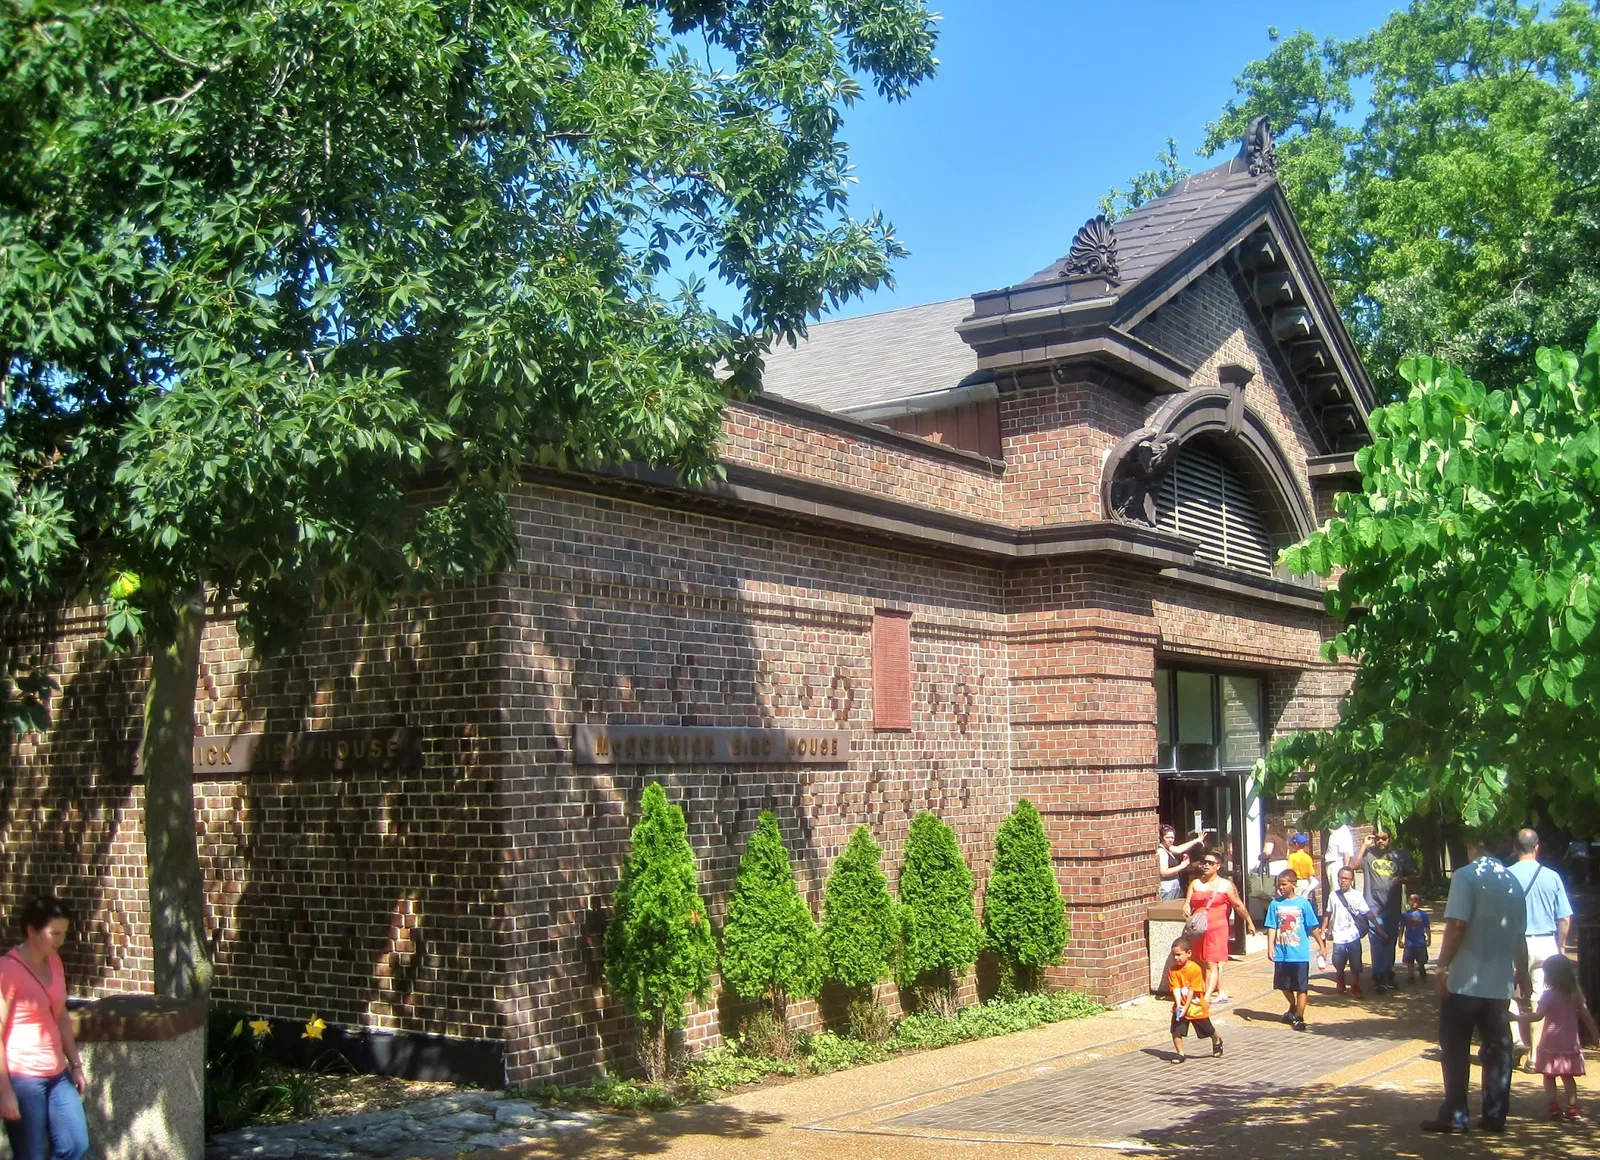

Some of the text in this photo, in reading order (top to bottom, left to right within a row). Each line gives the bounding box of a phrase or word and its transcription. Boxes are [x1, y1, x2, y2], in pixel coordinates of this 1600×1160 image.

[117, 740, 398, 767] McICK BIRD HOUSE
[731, 737, 773, 756] BIRD
[787, 738, 838, 756] HOUSE
